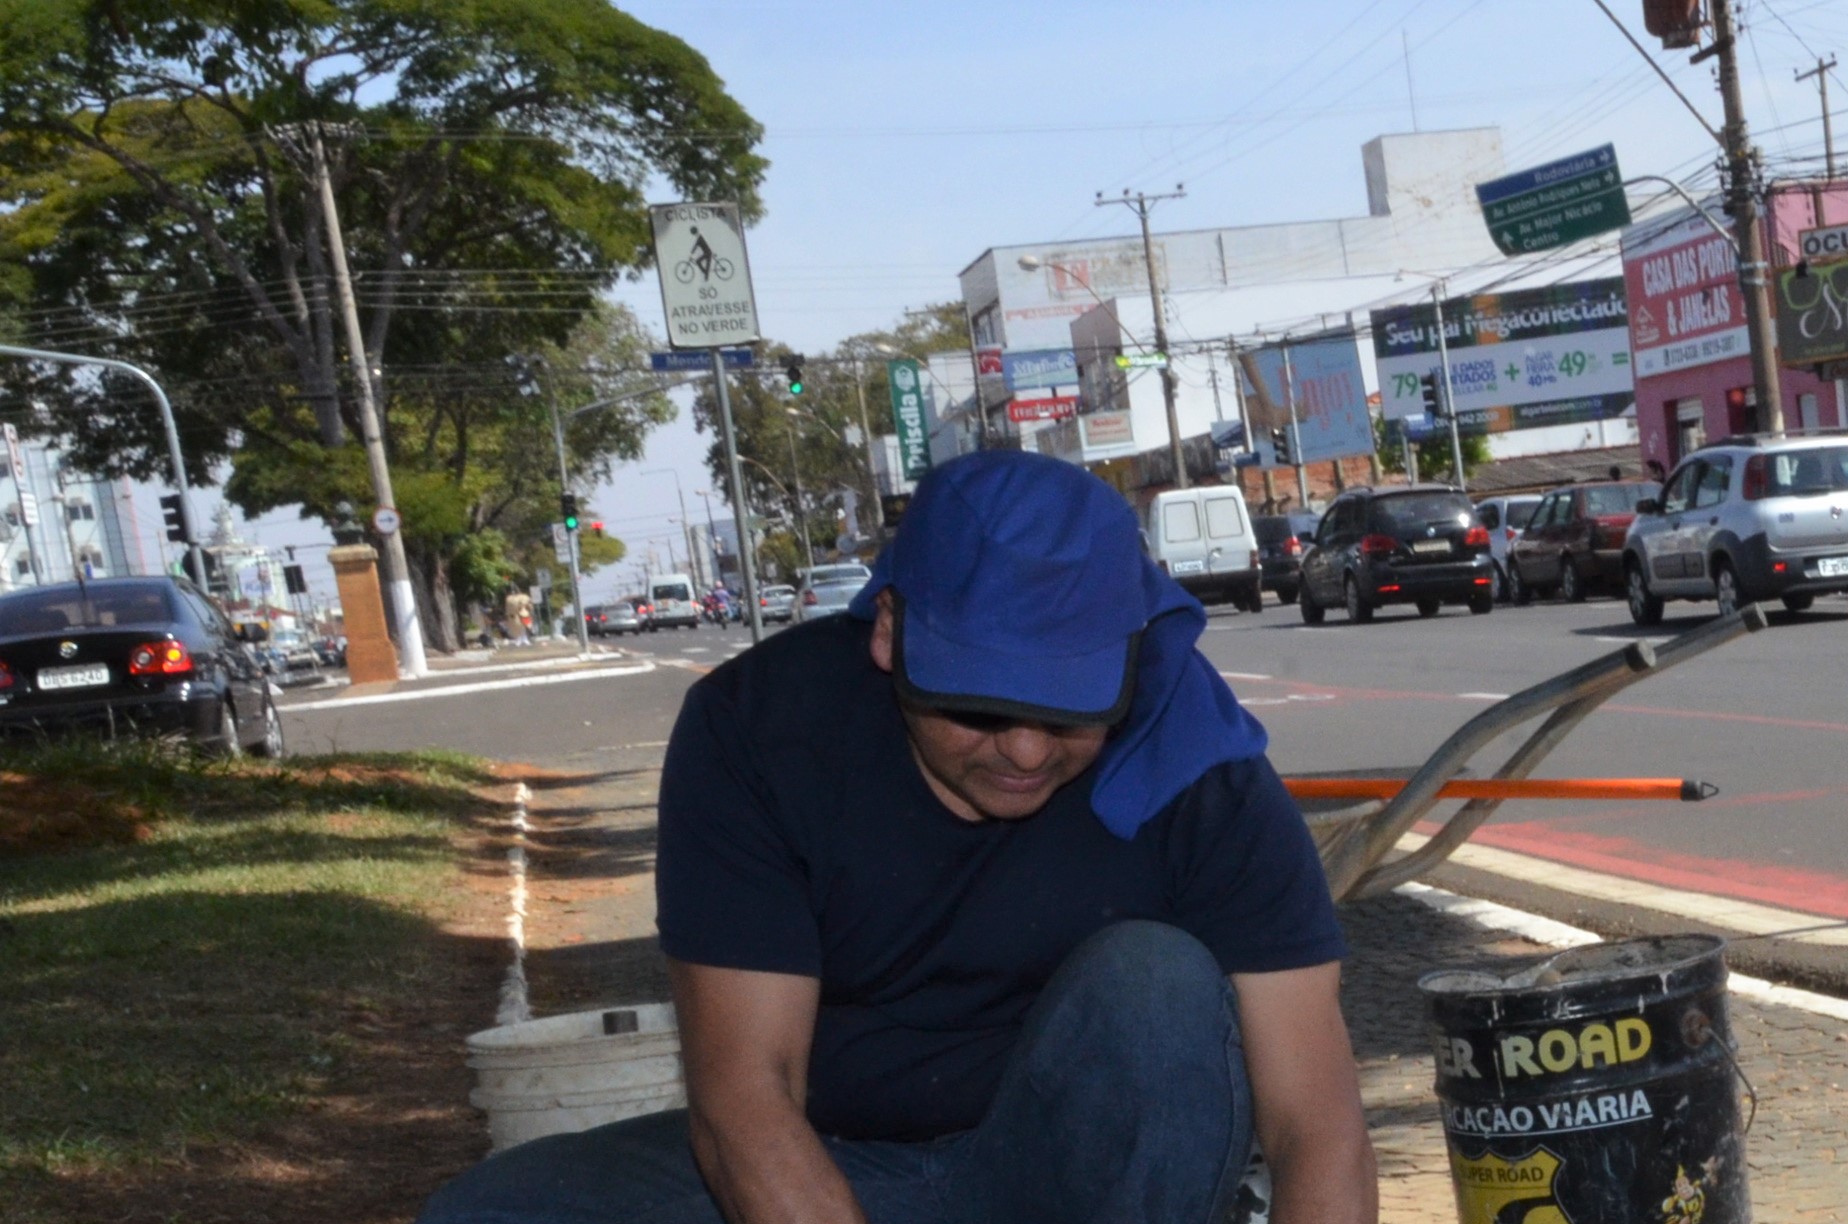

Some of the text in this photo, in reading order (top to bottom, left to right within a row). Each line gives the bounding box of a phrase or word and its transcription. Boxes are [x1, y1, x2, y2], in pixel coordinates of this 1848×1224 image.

[664, 207, 727, 222] CICLISTA
[1643, 238, 1737, 297] CASA DAS PORTA
[671, 301, 751, 319] ATRAVESSE
[678, 319, 748, 335] NO VERDE
[1385, 322, 1424, 346] Seu
[1558, 350, 1586, 378] 49
[1391, 372, 1419, 400] 79
[1500, 1017, 1652, 1079] ROAD
[1538, 1089, 1653, 1130] VIÁRIA
[1498, 1166, 1544, 1183] ROAD
